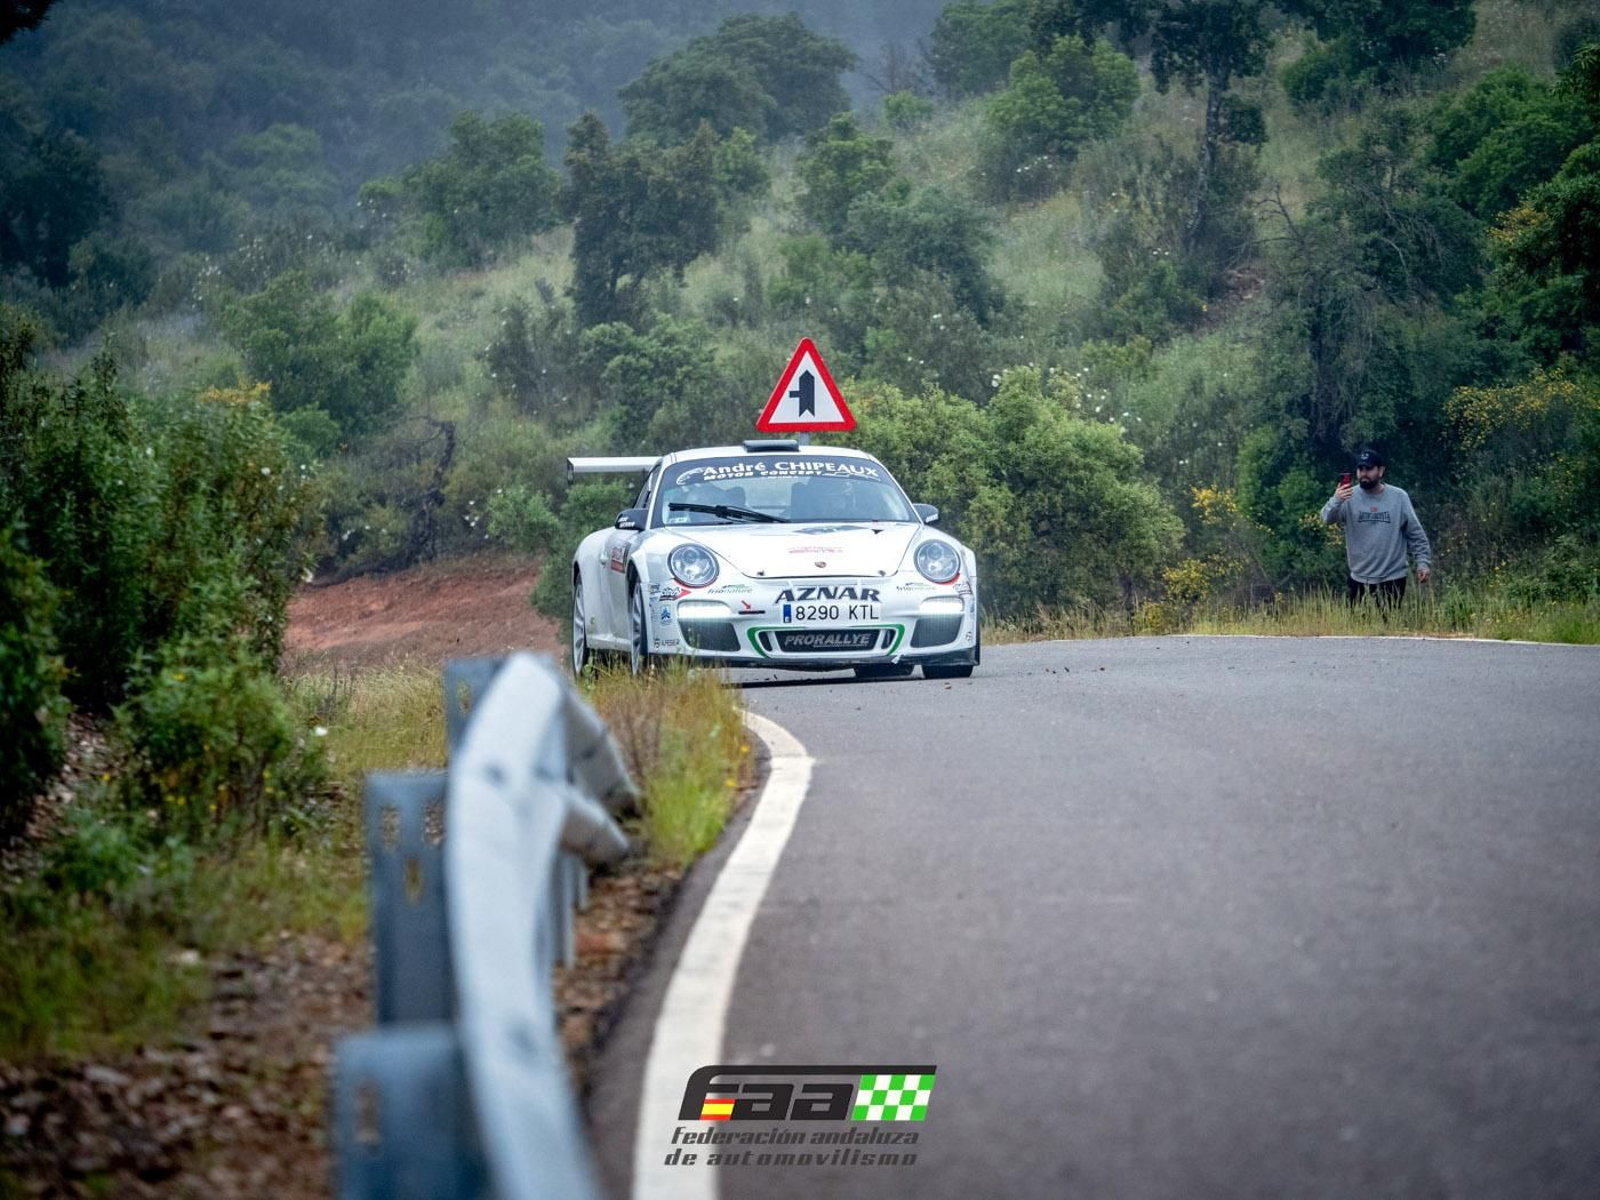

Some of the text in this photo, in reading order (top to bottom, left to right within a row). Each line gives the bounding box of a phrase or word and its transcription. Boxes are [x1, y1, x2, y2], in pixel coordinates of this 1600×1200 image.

[703, 461, 880, 477] André CHIPEAUX
[774, 586, 882, 604] AZNAR
[795, 604, 879, 621] 8290 KTL
[785, 633, 872, 647] PRORALLYE
